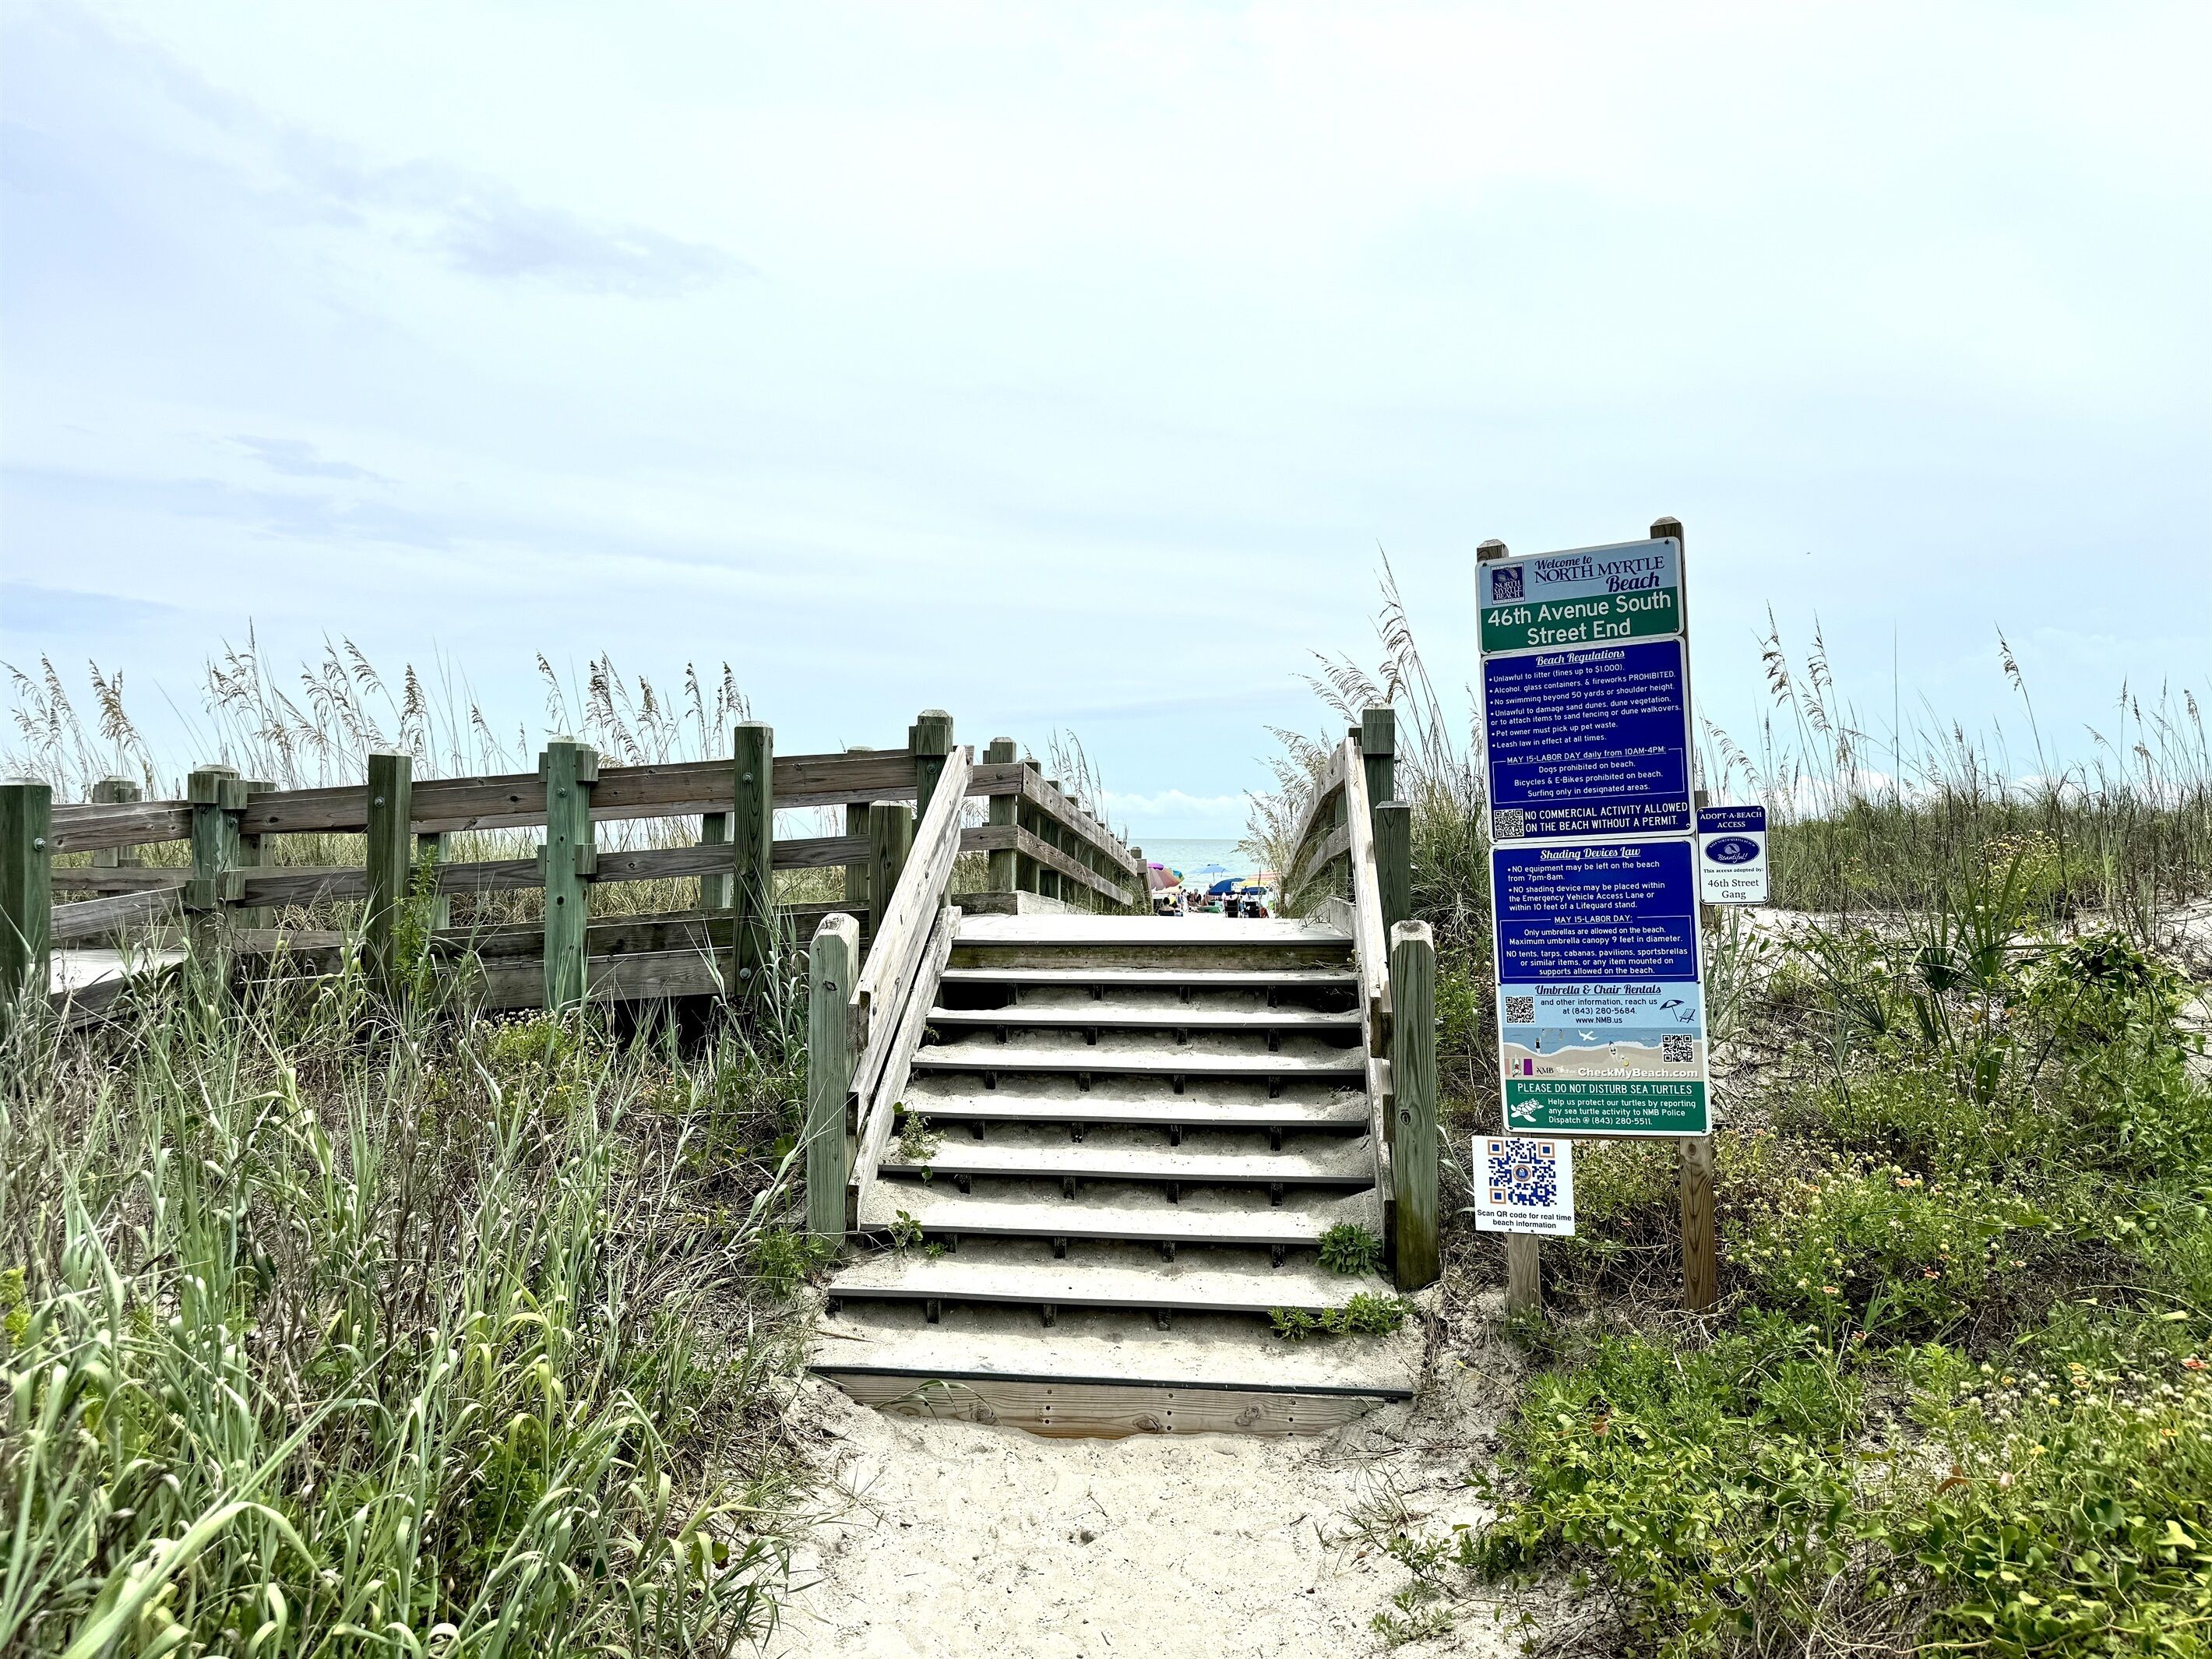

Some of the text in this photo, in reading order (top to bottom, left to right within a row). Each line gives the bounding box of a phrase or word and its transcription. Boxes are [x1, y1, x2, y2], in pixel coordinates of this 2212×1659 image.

[1534, 558, 1580, 569] Welcome
[1583, 555, 1592, 565] to
[1534, 556, 1665, 583] NORTH MYRTLE
[1605, 572, 1660, 593] Beach
[1488, 591, 1671, 626] 46th Avenue South
[1527, 618, 1630, 645] Street End
[1536, 650, 1625, 666] Beach Regulations
[1552, 725, 1568, 734] pick
[1581, 723, 1593, 731] pet
[1527, 753, 1562, 762] 15-LABOR
[1625, 746, 1665, 755] 10AM-4PM:
[1559, 763, 1597, 773] prohibited
[1586, 773, 1624, 783] prohibited
[1583, 784, 1625, 794] designated
[1525, 802, 1688, 820] NO COMMERCIAL ACTIVITY ALLOWED
[1526, 815, 1678, 833] ON THE BEACH WITHOUT A PERMIT.
[1540, 847, 1640, 861] Shading Devices Law
[1614, 882, 1640, 891] placed
[1708, 879, 1729, 887] 46th
[1523, 893, 1564, 902] Emergency
[1721, 890, 1746, 900] Gang
[1535, 984, 1661, 995] Umbrella & Chair Rentals
[1578, 1066, 1698, 1080] CheckMyBeach.com
[1517, 1083, 1692, 1094] PLEASE DO NOT DISTURB SEA TURTLES
[1548, 1098, 1565, 1107] Help
[1648, 1100, 1658, 1108] by
[1661, 1100, 1696, 1108] reporting
[1548, 1116, 1581, 1125] Dispatch
[1615, 1116, 1652, 1125] 280-5511.
